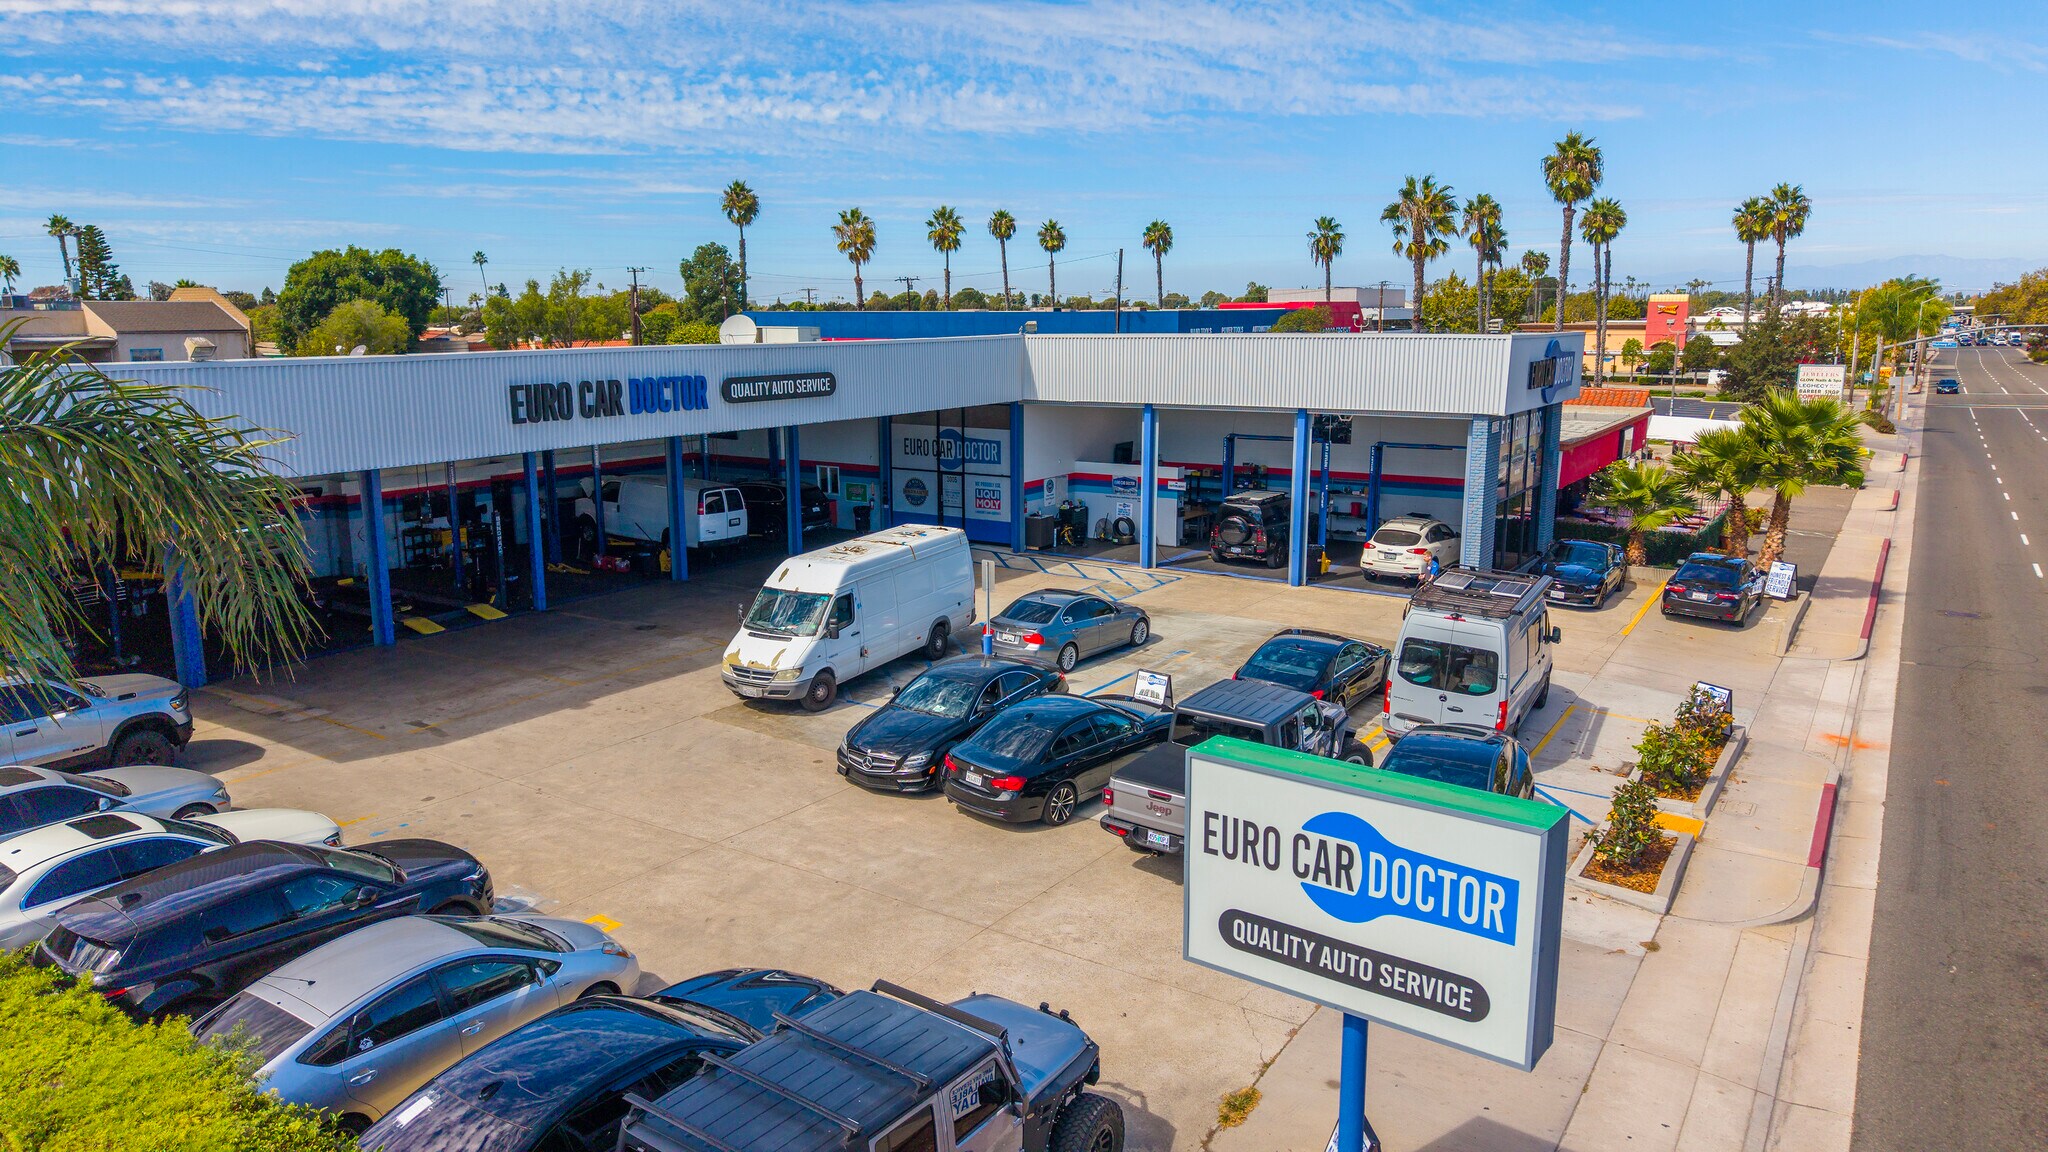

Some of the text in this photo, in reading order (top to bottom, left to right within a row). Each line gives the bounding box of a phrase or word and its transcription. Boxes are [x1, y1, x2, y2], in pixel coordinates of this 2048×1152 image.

[730, 378, 831, 398] QUALITY AUTO SERVICE
[509, 375, 709, 424] EURO CAR DOCTOR
[904, 438, 998, 461] EURO CAR DOCTOR
[976, 489, 1000, 499] LIQUI
[976, 499, 1000, 509] MOLY
[1766, 584, 1788, 595] SERVICE
[1146, 801, 1172, 816] Jeep
[1204, 810, 1506, 934] EURO CAR DOCTOR
[1233, 919, 1473, 1012] QUALITY AUTO SERVICE
